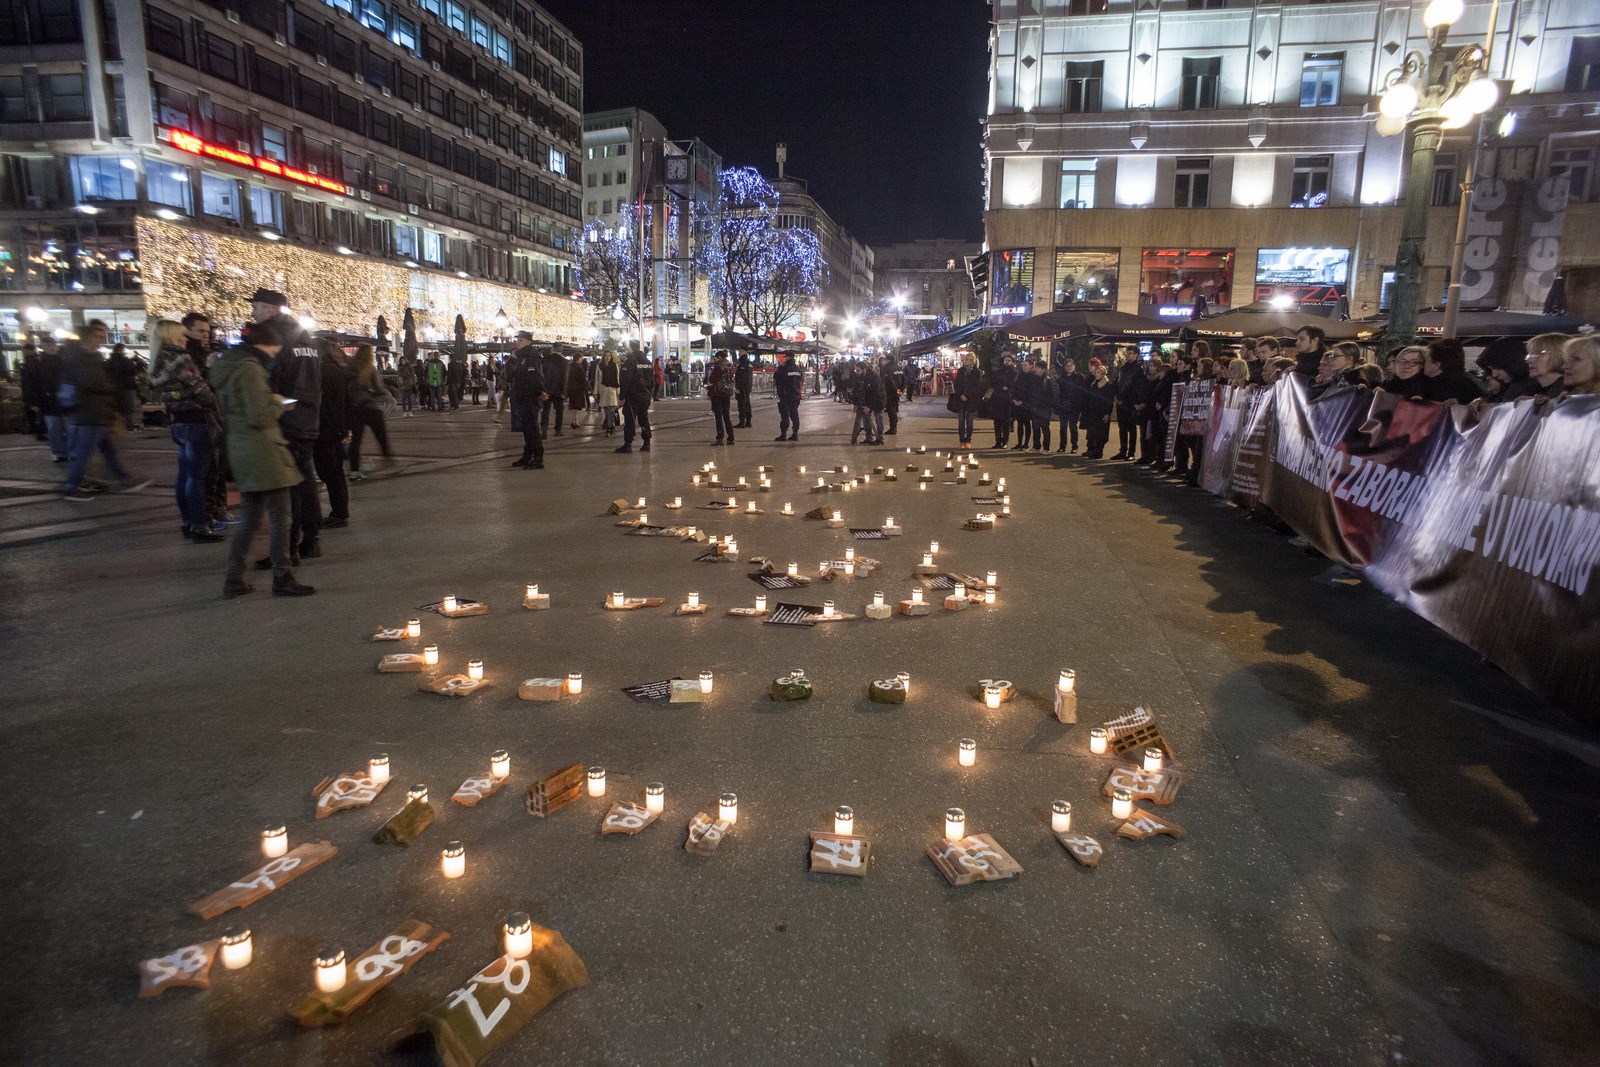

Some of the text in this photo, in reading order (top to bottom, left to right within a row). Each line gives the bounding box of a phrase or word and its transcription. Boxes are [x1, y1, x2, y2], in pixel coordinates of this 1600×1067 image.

[1255, 286, 1341, 303] PZZA
[990, 306, 1025, 316] BOUTIQUE
[1008, 331, 1071, 343] BOUTIQUE
[1197, 329, 1243, 337] BOUTIQUE
[606, 806, 650, 828] 79
[147, 945, 209, 985] 85
[357, 935, 428, 981] 86
[448, 954, 531, 1038] 87
